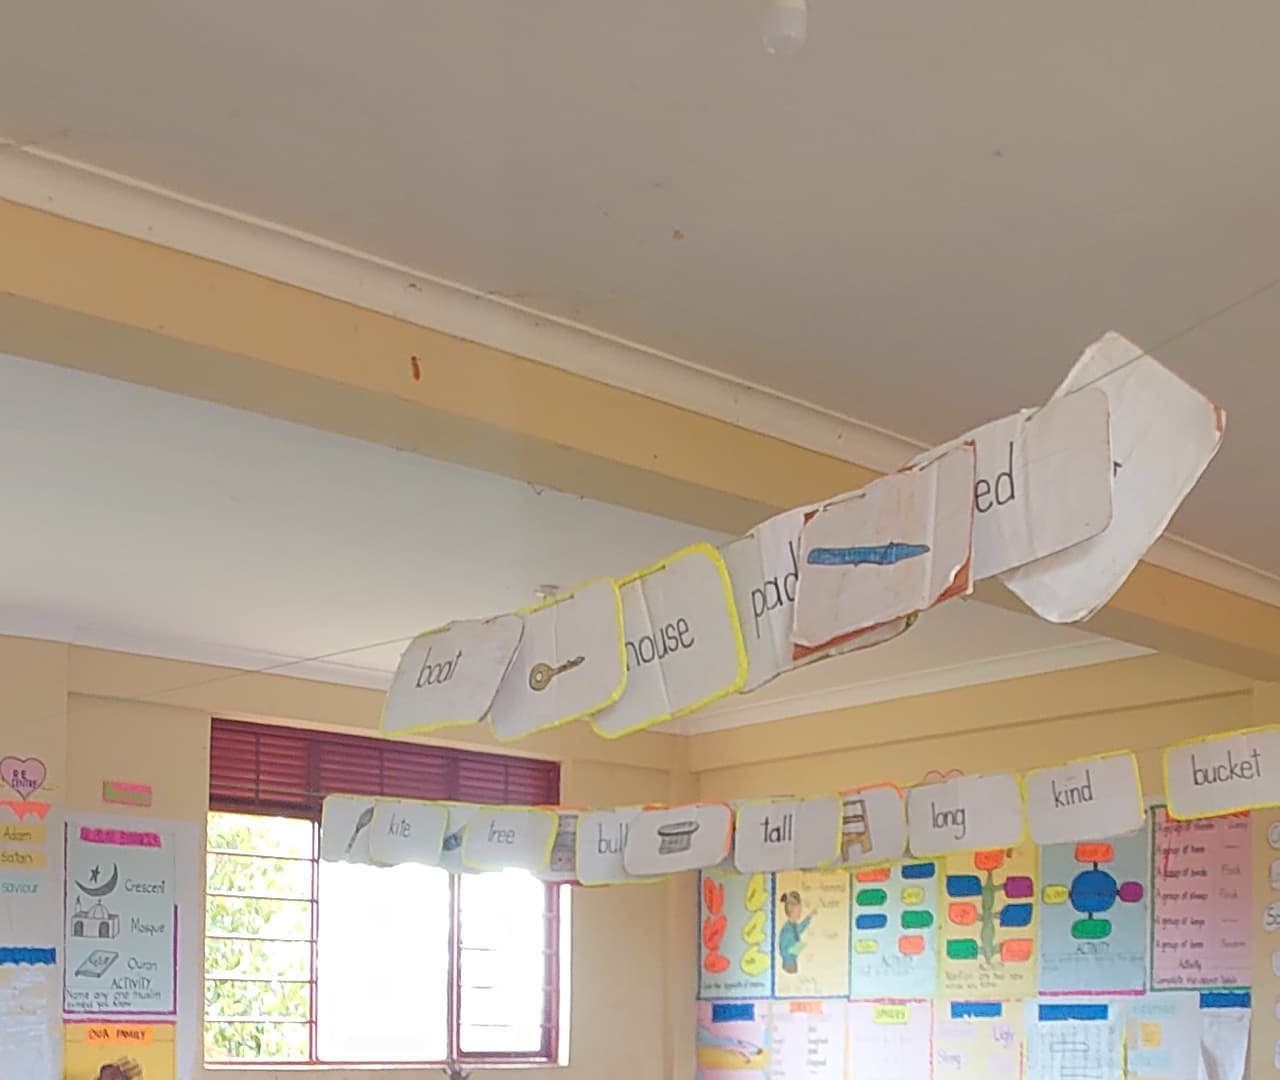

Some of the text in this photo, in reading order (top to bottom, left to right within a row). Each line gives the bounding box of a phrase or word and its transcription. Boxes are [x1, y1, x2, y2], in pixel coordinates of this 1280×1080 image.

[416, 648, 462, 688] boat
[1192, 749, 1261, 787] bucket
[1054, 782, 1094, 810] kind
[388, 812, 411, 839] kite
[487, 819, 515, 844] tree
[762, 814, 793, 843] tall
[932, 802, 966, 840] long
[125, 879, 166, 894] Crescent
[131, 917, 165, 936] Mosque
[111, 977, 152, 990] ACTIVITY
